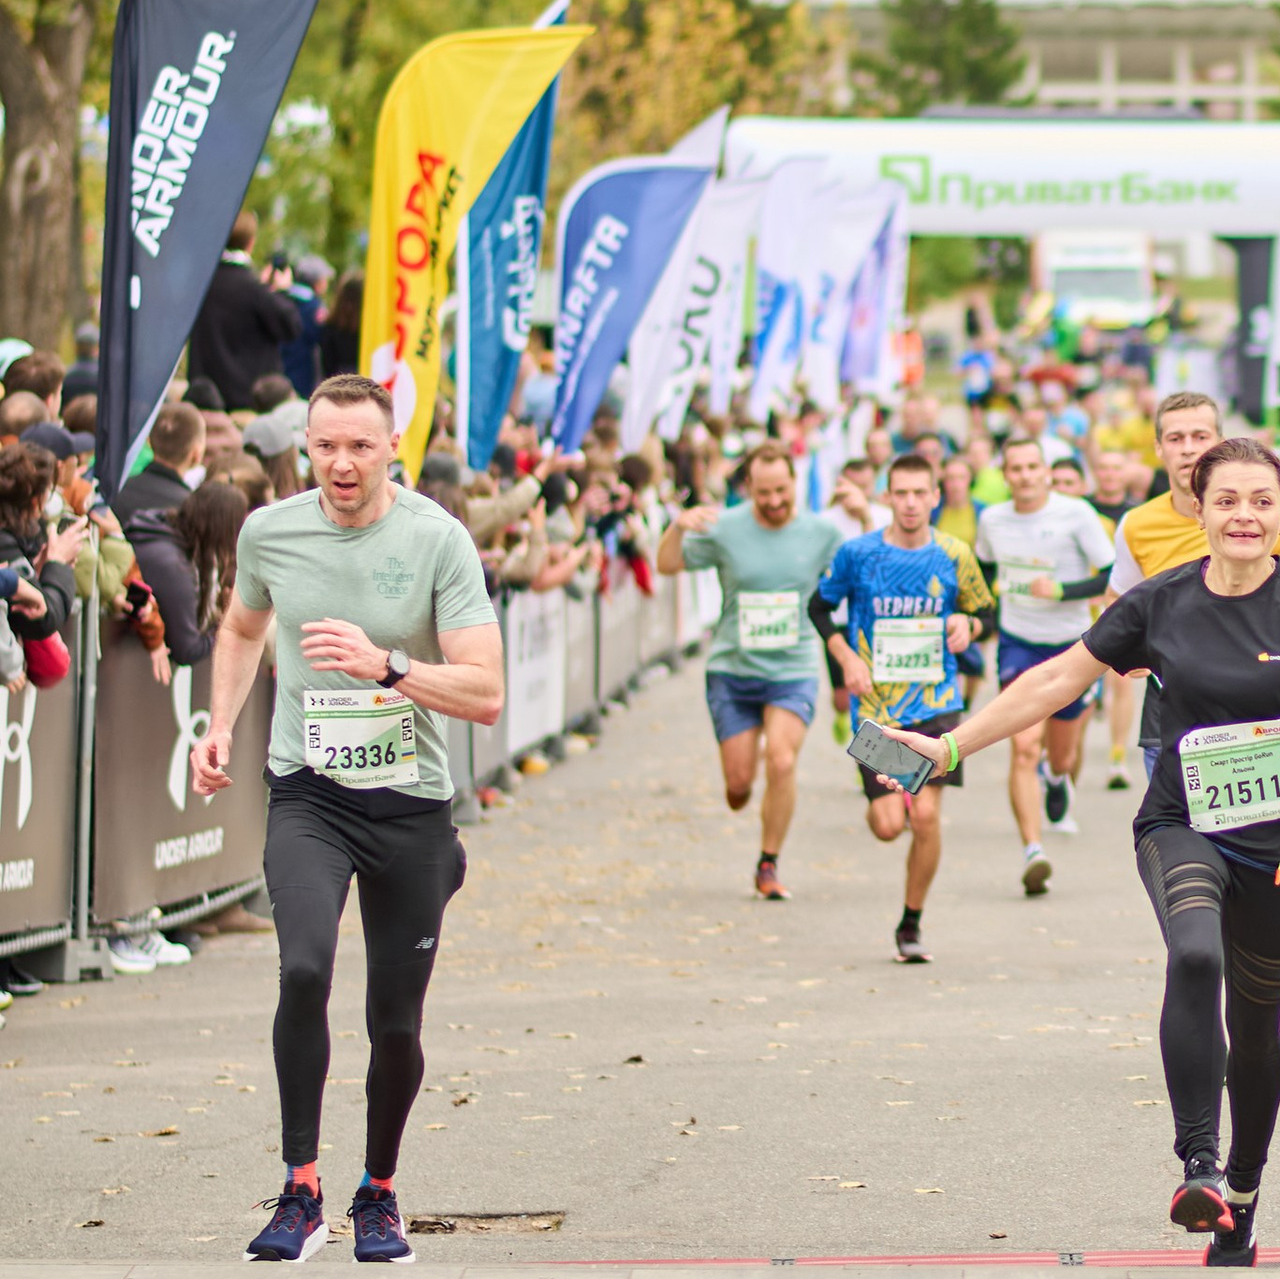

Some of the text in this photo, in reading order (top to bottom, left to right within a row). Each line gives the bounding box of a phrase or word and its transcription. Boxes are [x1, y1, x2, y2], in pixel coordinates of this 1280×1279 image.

[134, 30, 235, 259] ARMOUR
[938, 172, 1241, 211] ПриватБанк
[372, 568, 415, 585] Intelligent
[376, 582, 409, 595] Choice
[885, 653, 930, 668] 23273
[325, 741, 396, 770] 23336
[1210, 759, 1229, 767] Смарт
[1229, 755, 1253, 766] Простір
[1231, 765, 1255, 775] Альона
[341, 773, 397, 784] ПриватБанк
[1205, 774, 1280, 810] 21511
